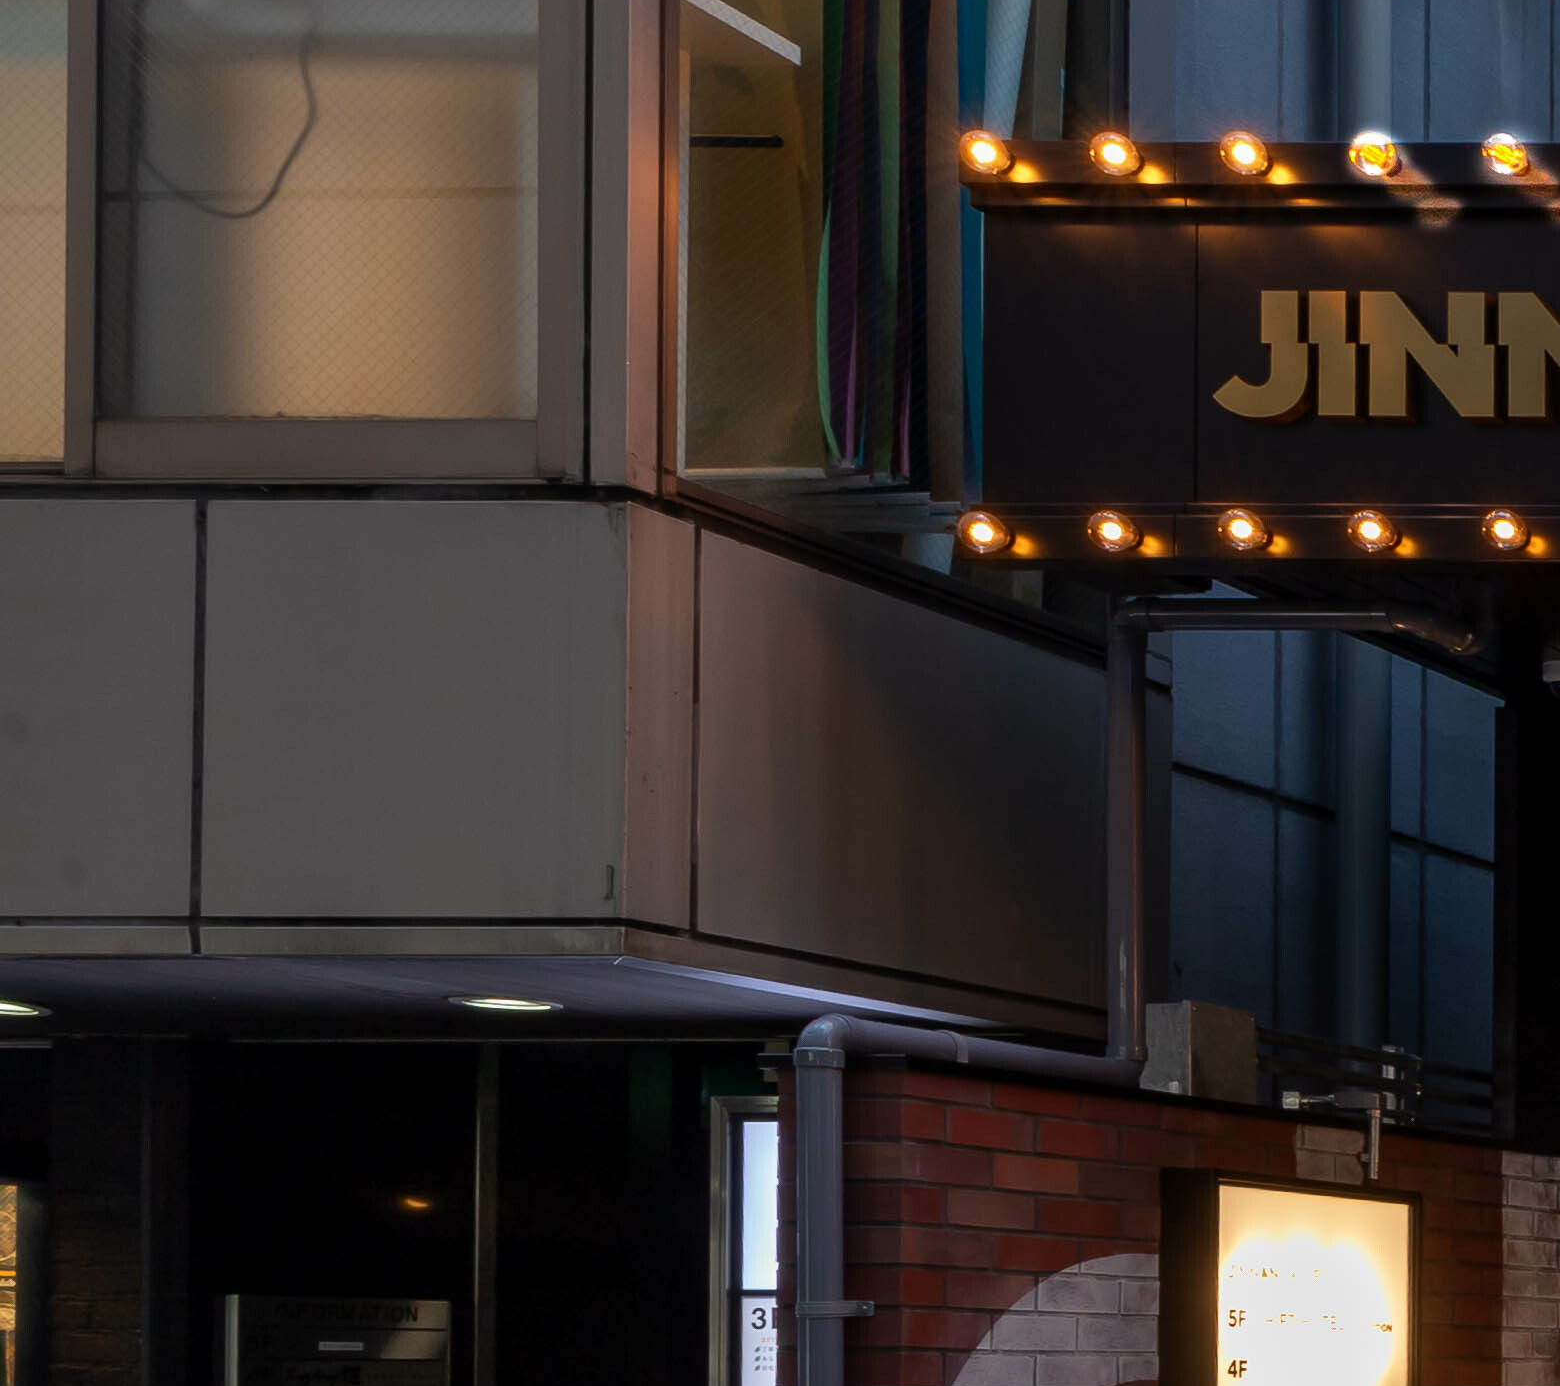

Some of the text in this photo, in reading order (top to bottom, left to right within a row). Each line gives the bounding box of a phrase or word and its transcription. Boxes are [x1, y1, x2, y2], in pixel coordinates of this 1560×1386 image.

[751, 1307, 777, 1330] 3
[1226, 1309, 1247, 1329] 5F
[1226, 1358, 1248, 1379] 4F
